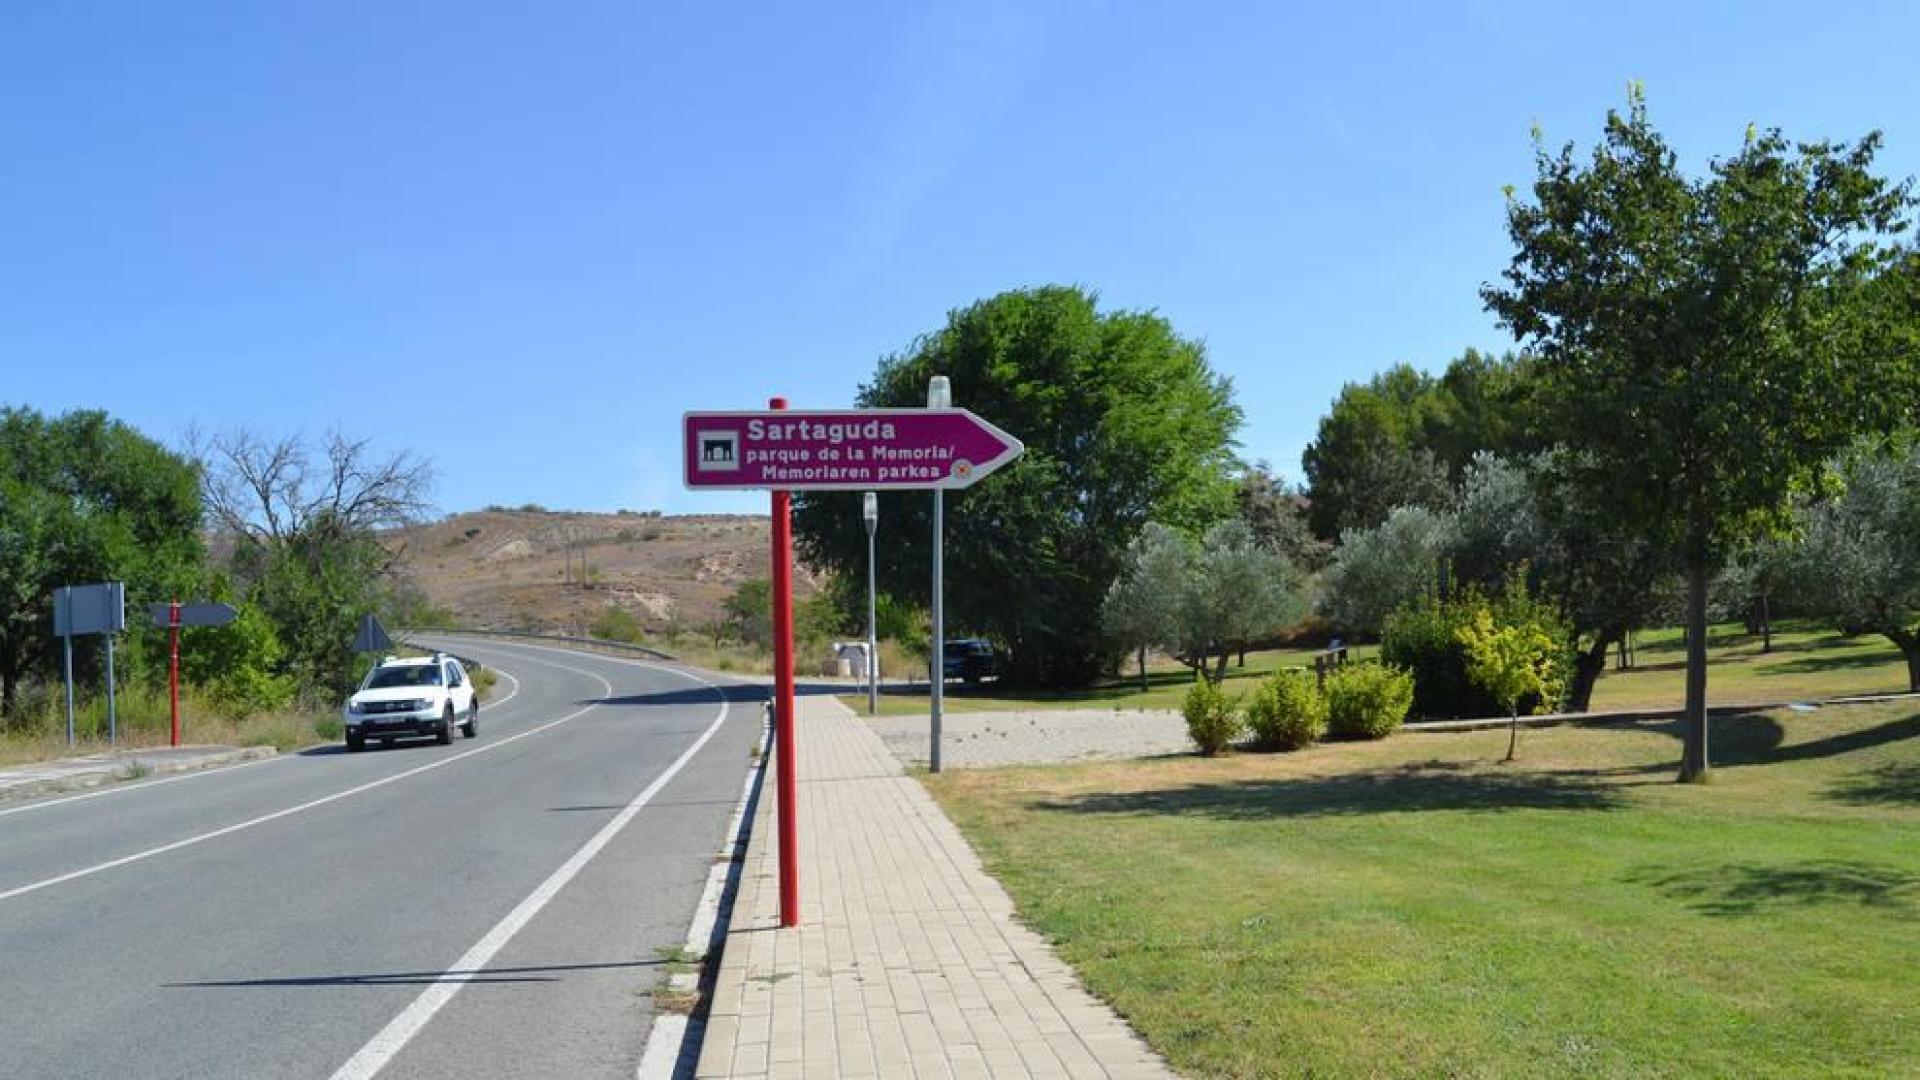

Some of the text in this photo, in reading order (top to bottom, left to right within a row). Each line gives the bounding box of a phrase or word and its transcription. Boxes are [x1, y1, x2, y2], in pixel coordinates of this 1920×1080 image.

[746, 420, 896, 444] Sartaguda
[746, 448, 810, 464] parque
[818, 446, 839, 461] de
[847, 446, 864, 460] la
[761, 464, 941, 482] Memoriaren parkea
